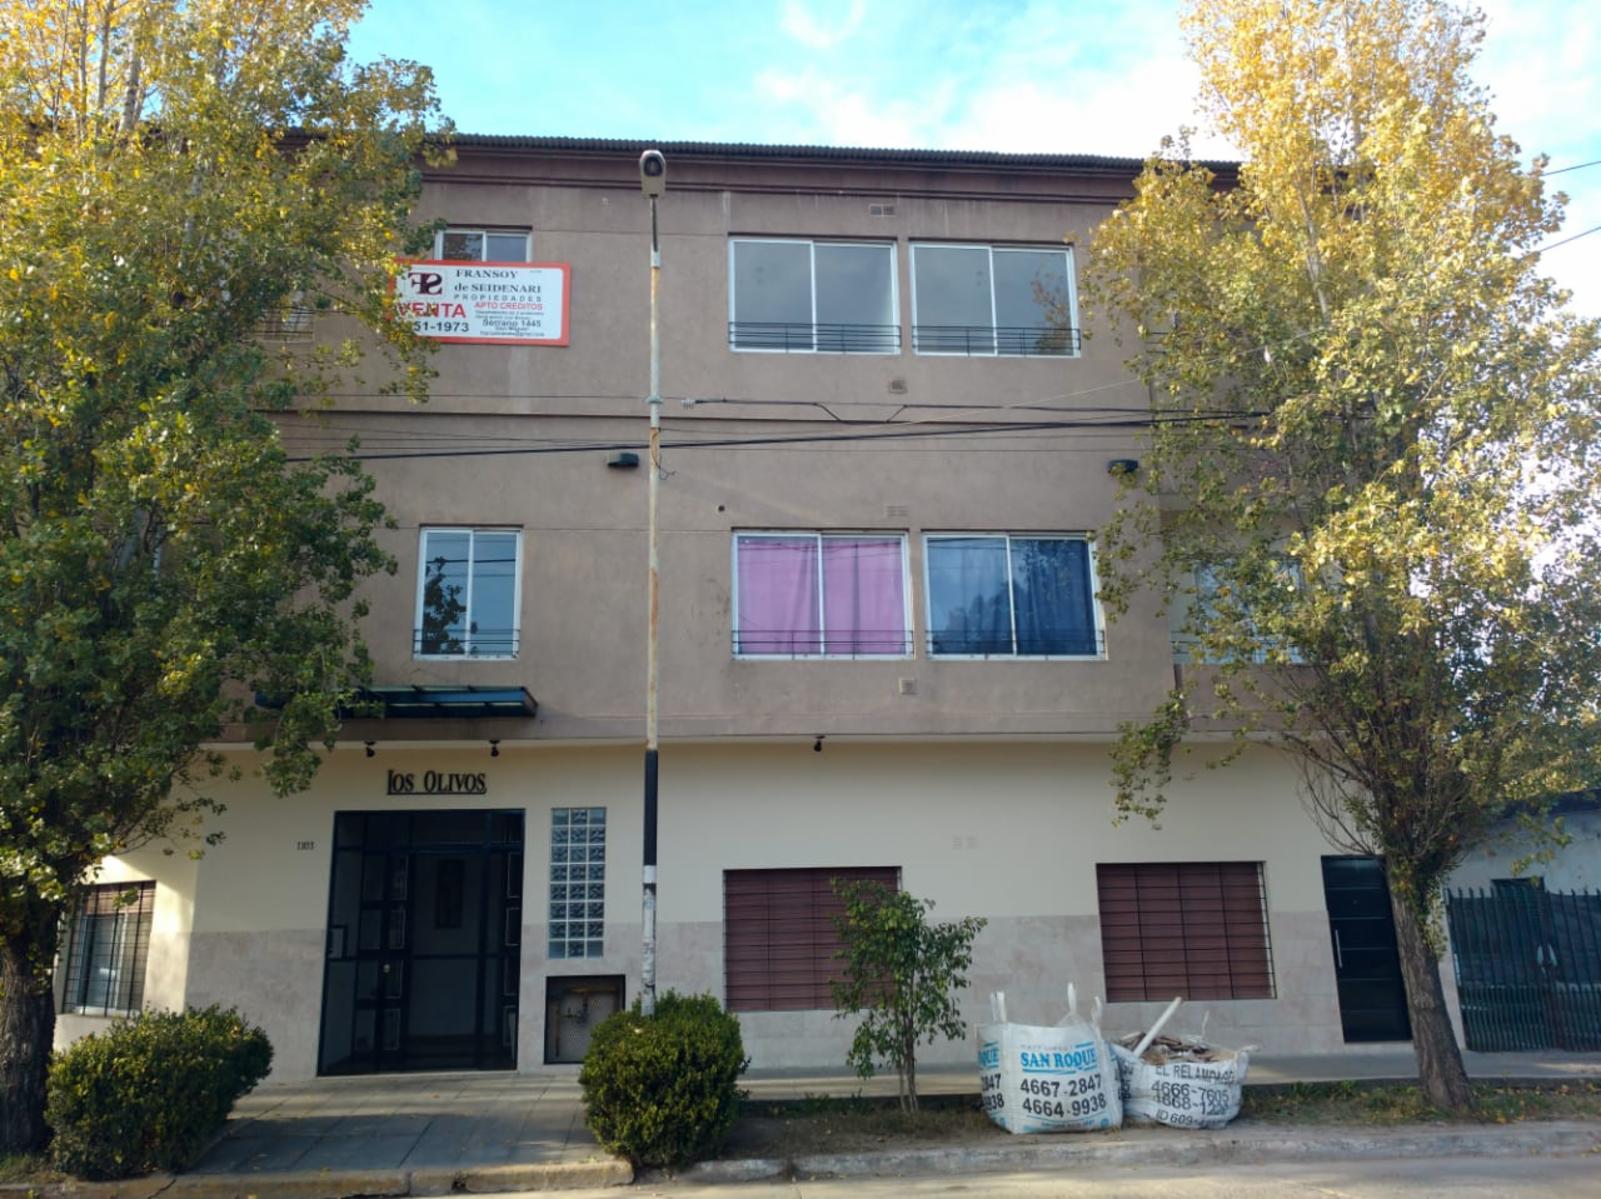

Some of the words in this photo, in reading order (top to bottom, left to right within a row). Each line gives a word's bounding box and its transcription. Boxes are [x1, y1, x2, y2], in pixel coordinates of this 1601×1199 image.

[456, 269, 519, 279] FRANSOY
[454, 283, 467, 292] de
[472, 284, 541, 294] SEIDENARI
[454, 294, 542, 302] PROPIEDADES
[396, 302, 467, 318] VENTA
[473, 302, 498, 310] APTO
[387, 769, 415, 795] LOS
[424, 769, 488, 794] OLIVOS
[1020, 1051, 1050, 1068] SAN
[1055, 1047, 1097, 1069] ROQUE
